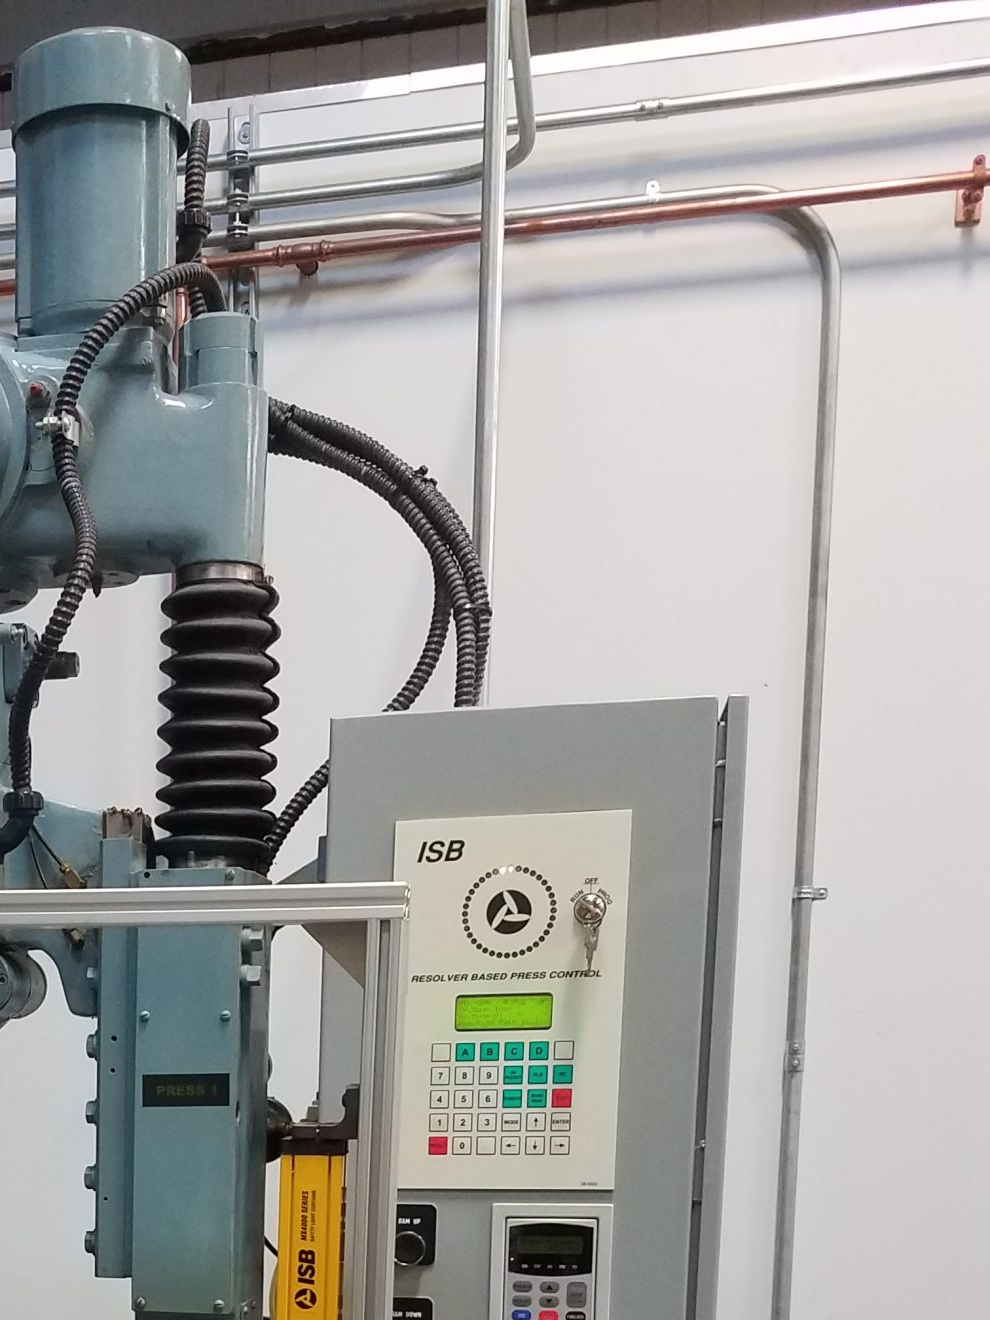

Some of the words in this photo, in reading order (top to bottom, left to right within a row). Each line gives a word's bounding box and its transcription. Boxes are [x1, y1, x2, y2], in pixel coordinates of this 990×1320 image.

[417, 840, 465, 863] ISB
[584, 877, 598, 885] OFF
[570, 889, 584, 903] RUN
[411, 973, 468, 983] RESOLVER
[471, 972, 508, 981] BASED
[510, 971, 547, 980] PRESS
[549, 969, 602, 978] CONTROL
[156, 1085, 205, 1096] PRESS
[301, 1190, 309, 1213] SERIES
[300, 1215, 308, 1241] MX4000
[297, 1249, 316, 1285] ISB
